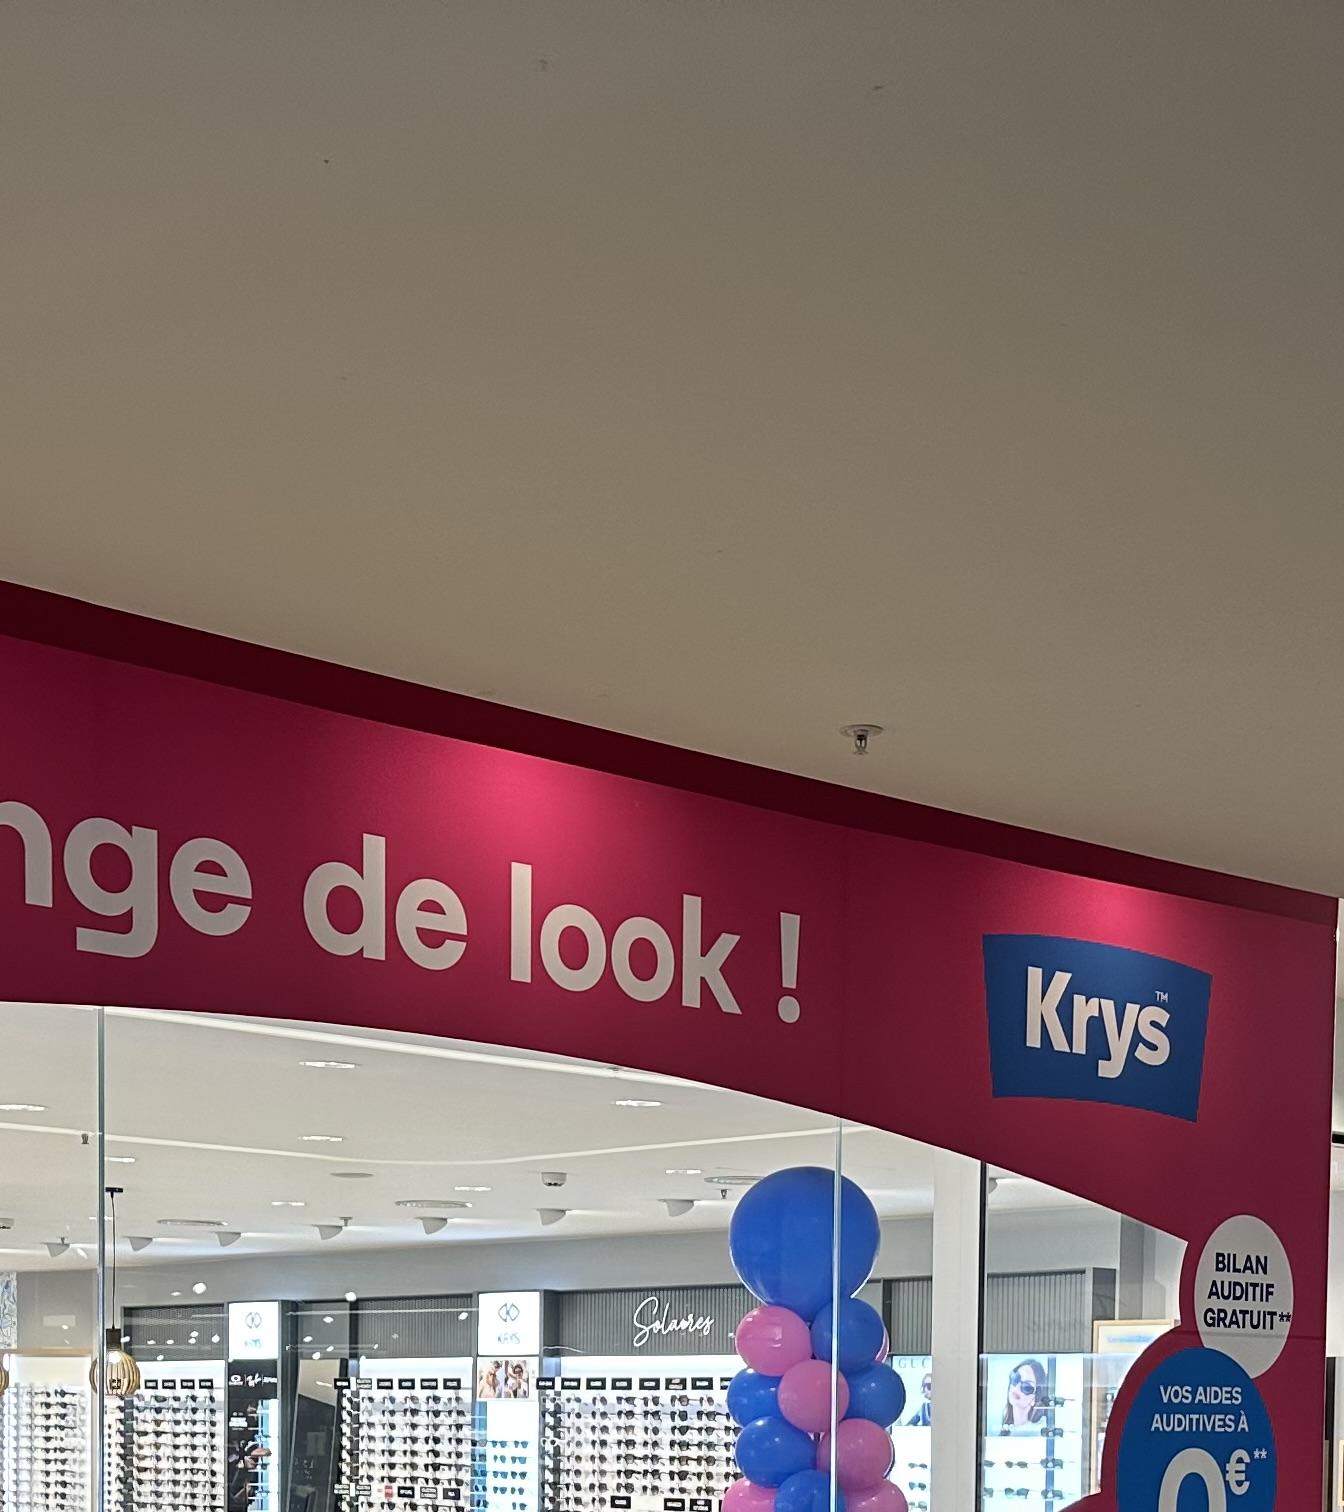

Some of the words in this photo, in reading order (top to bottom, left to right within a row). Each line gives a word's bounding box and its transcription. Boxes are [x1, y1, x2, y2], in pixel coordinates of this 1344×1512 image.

[303, 833, 468, 971] de
[510, 862, 742, 1015] look
[778, 911, 801, 1024] !
[1026, 966, 1171, 1079] Krys
[1215, 1252, 1268, 1275] BILAN
[1207, 1280, 1275, 1302] AUDITIF
[1160, 1385, 1192, 1404] VOS
[1194, 1386, 1242, 1405] AIDES
[1150, 1413, 1235, 1432] AUDITIVES
[1237, 1410, 1249, 1432] À
